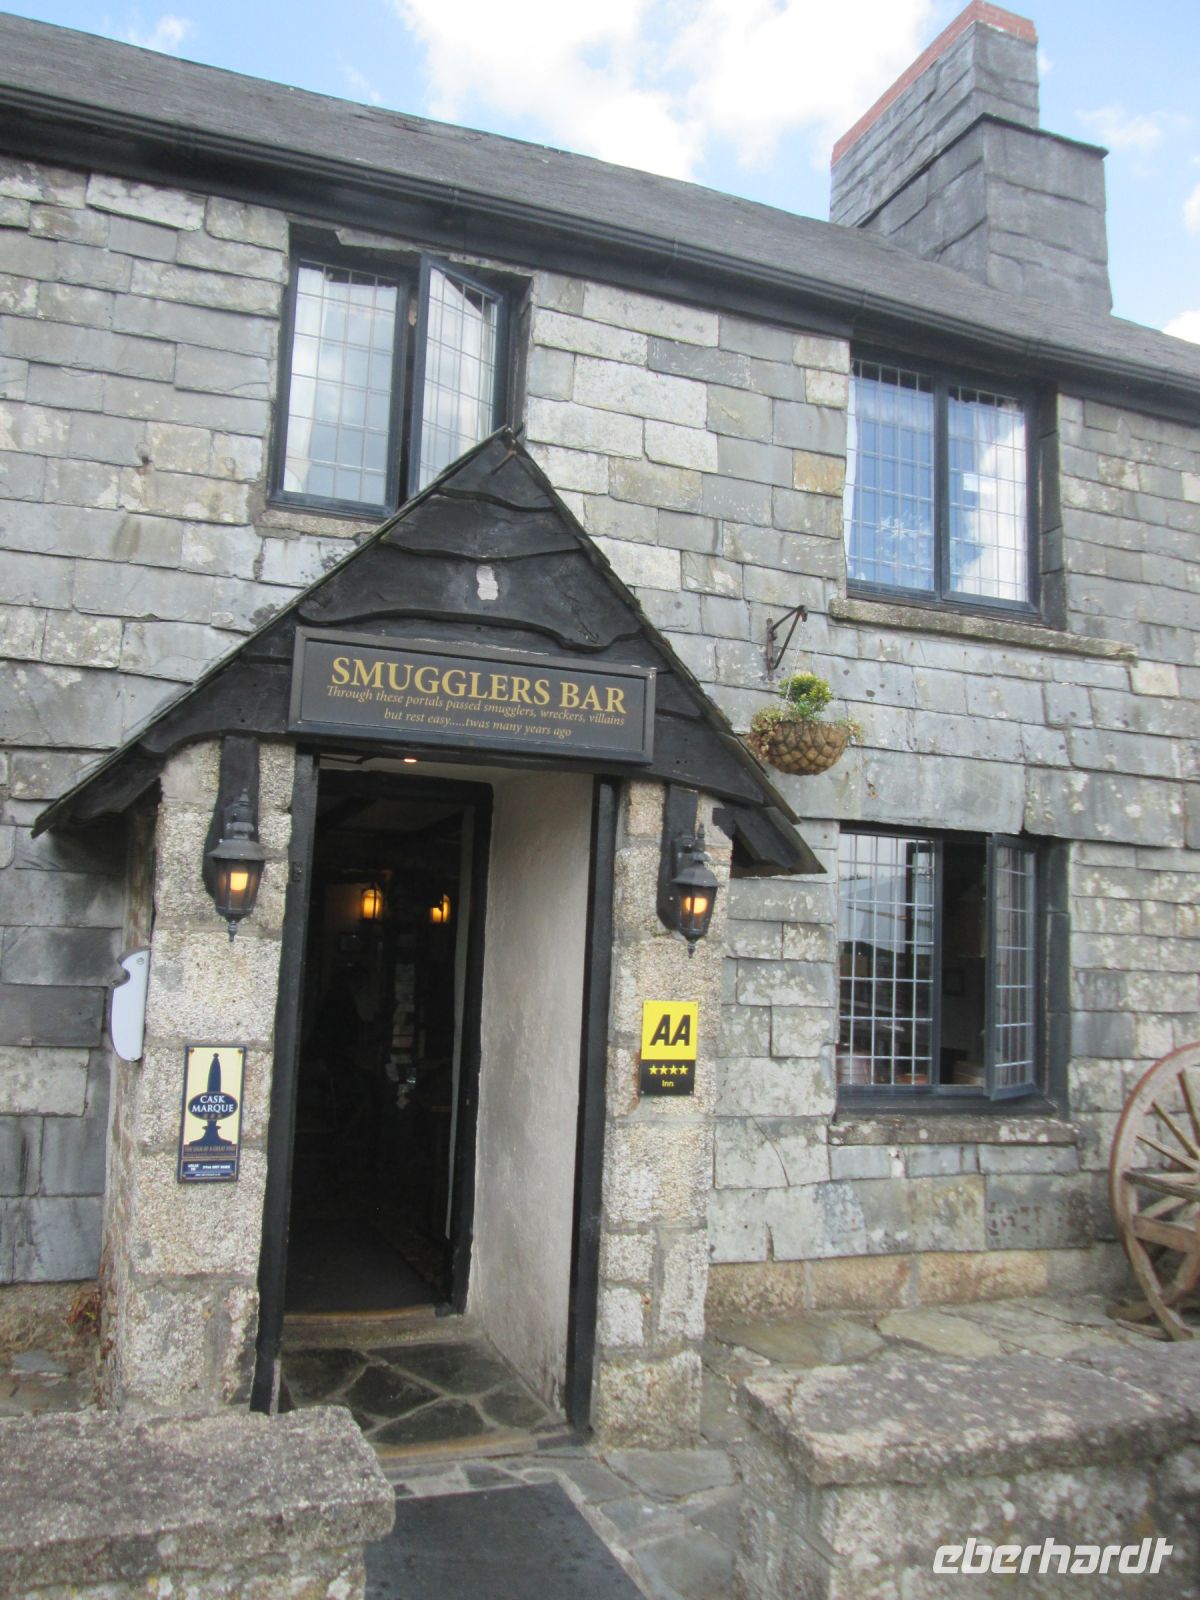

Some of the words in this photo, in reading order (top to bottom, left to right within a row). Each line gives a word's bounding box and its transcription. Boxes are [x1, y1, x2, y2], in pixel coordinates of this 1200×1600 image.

[331, 657, 550, 705] SMUGGLERS
[559, 681, 626, 714] BAR
[326, 685, 373, 703] Through
[375, 690, 402, 703] these
[405, 695, 443, 707] portals
[446, 700, 481, 712] passed
[483, 702, 537, 718] smugglers,
[540, 709, 586, 723] wreckers,
[589, 713, 625, 726] villains
[384, 707, 403, 721] but
[405, 713, 425, 723] rest
[492, 722, 523, 735] many
[524, 726, 551, 736] years
[553, 730, 572, 739] ago
[649, 1014, 691, 1047] AA
[191, 1104, 234, 1113] MARQUE
[200, 1095, 225, 1104] CASK
